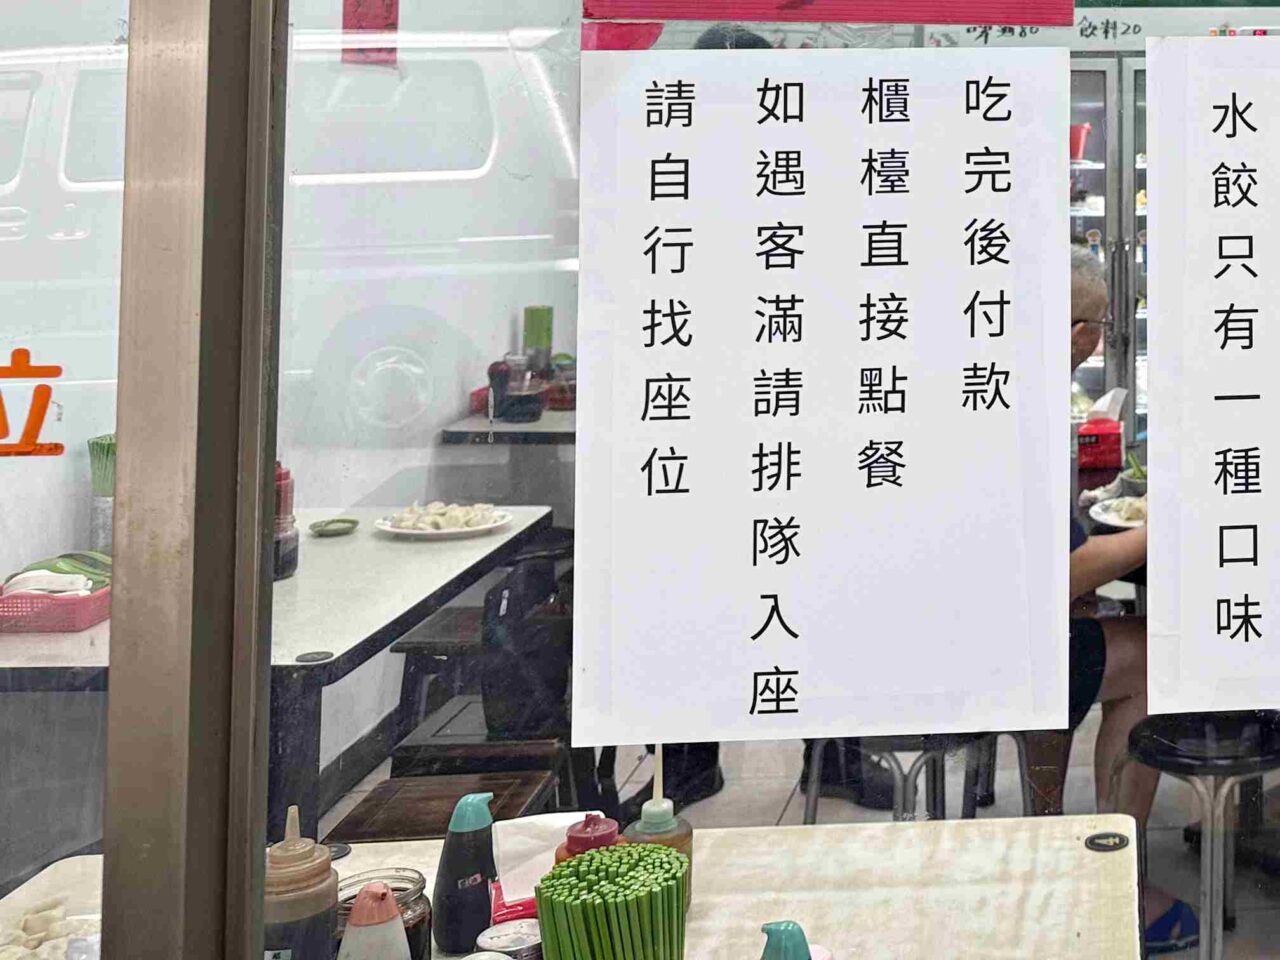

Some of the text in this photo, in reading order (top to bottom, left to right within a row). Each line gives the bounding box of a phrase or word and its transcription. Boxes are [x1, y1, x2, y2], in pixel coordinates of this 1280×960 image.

[1077, 16, 1142, 41] 飲料20
[640, 79, 696, 497] 請自行找座位
[749, 77, 806, 717] 如遇客滿請排隊入座
[856, 77, 911, 489] 櫃檯直接點餐
[962, 75, 1012, 411] 吃完後付款
[1212, 92, 1263, 643] 水餃只有一種口味
